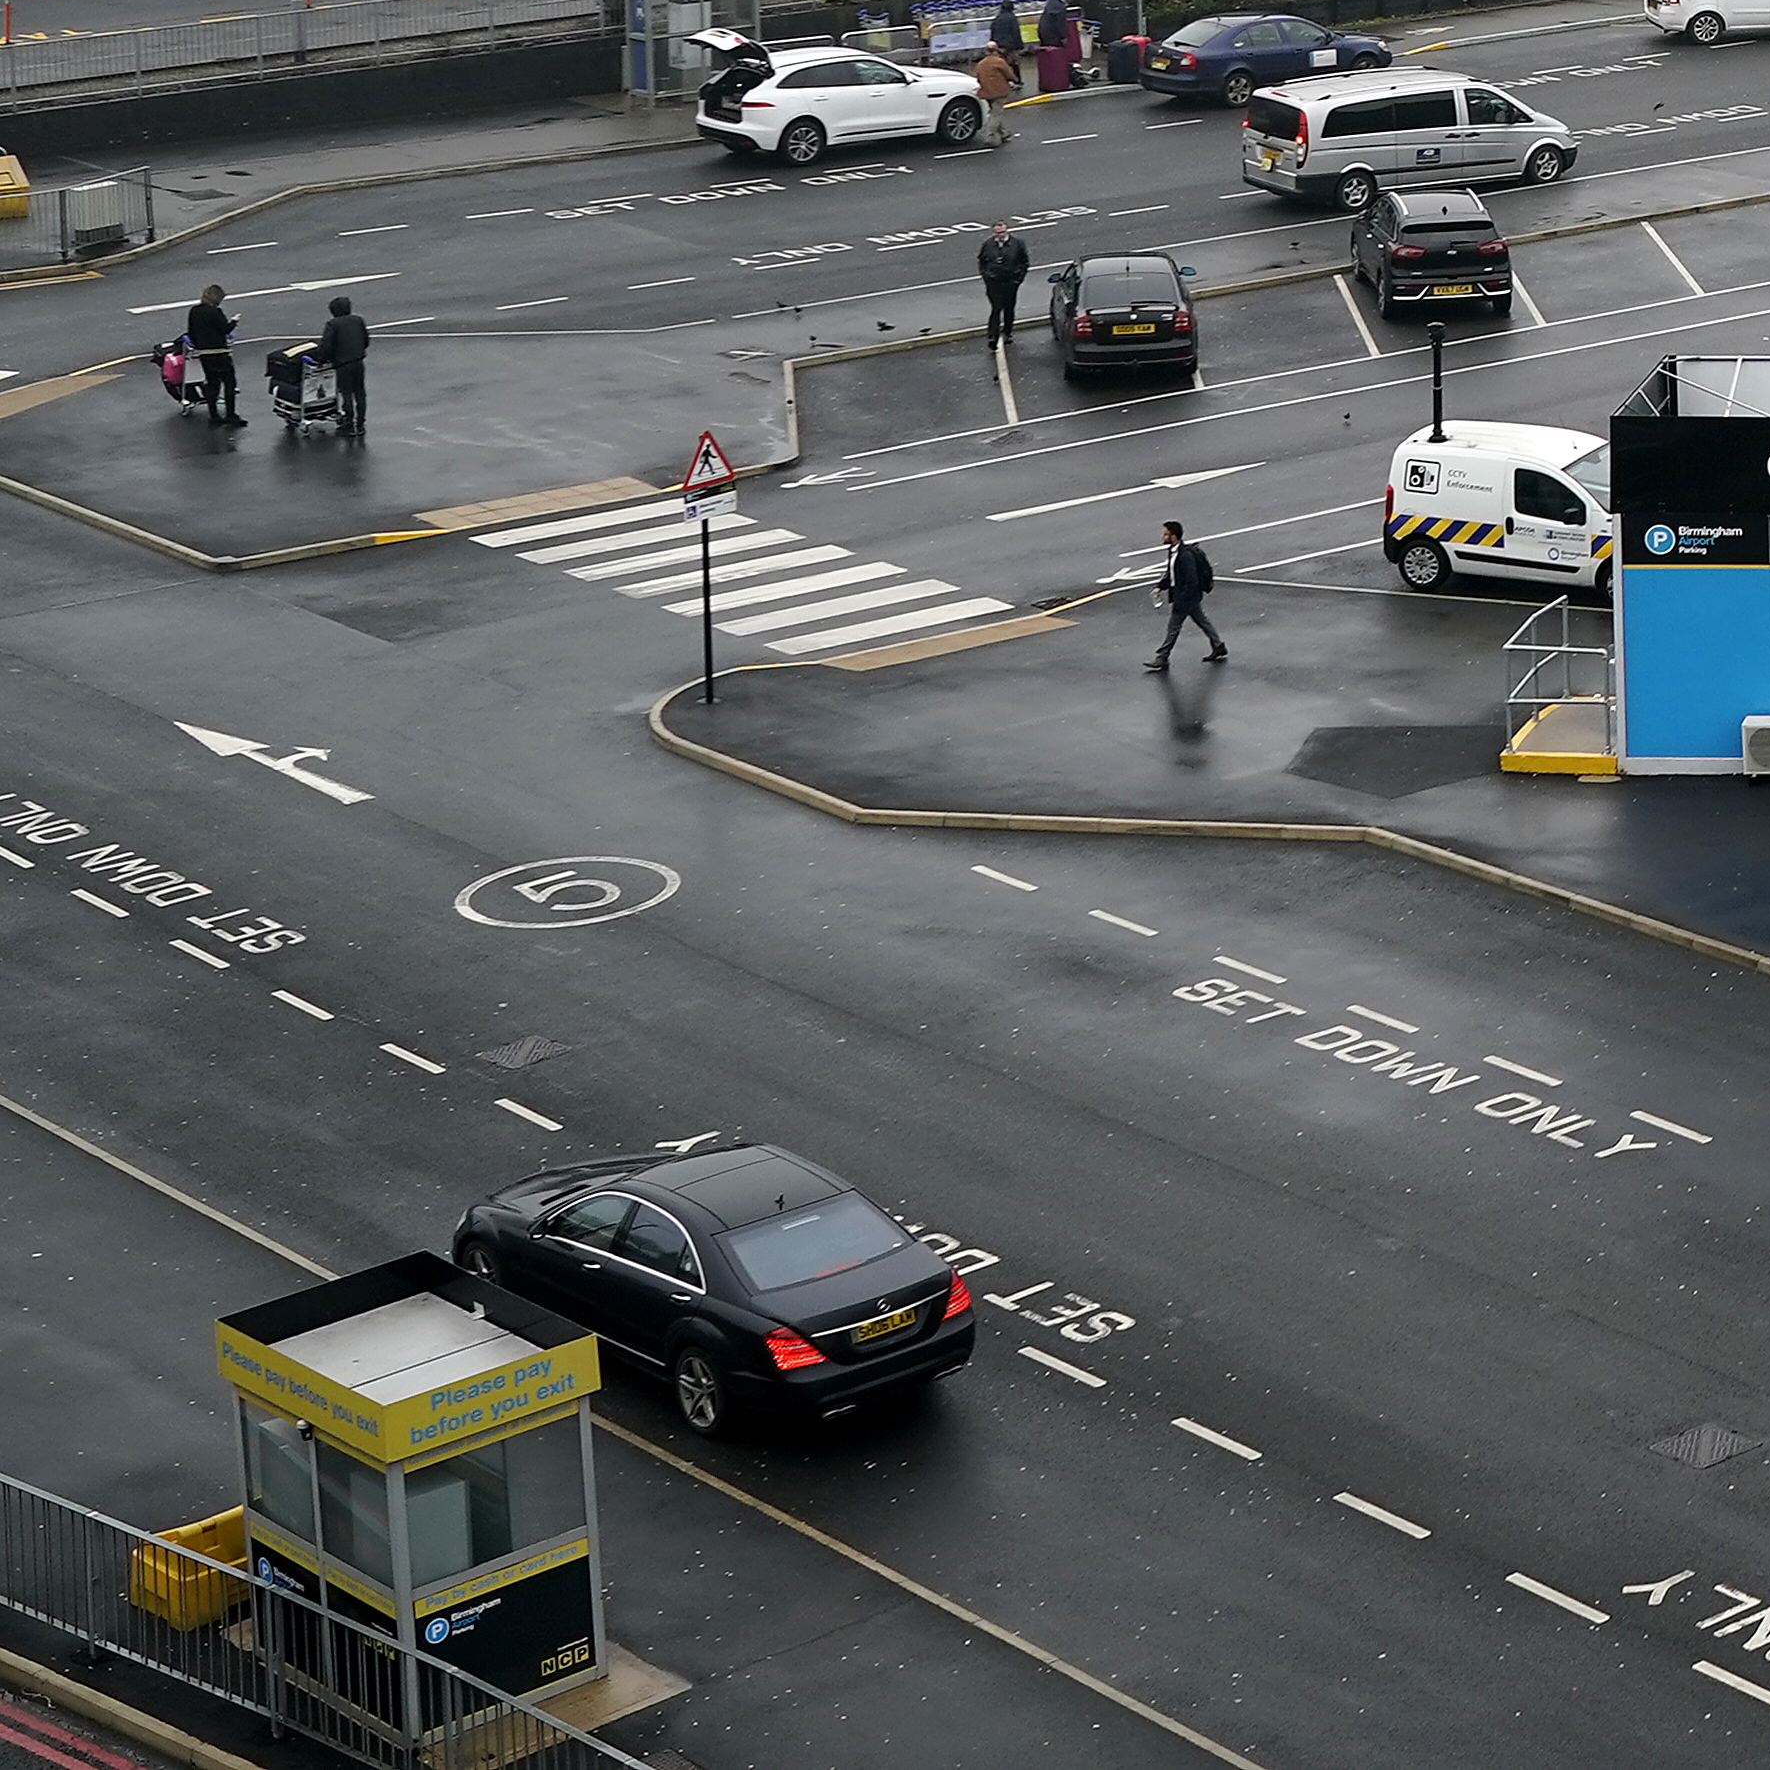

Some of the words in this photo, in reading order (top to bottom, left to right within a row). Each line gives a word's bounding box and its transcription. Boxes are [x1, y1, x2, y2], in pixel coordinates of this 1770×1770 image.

[1569, 59, 1662, 78] ONLY
[546, 201, 636, 220] SET
[658, 183, 786, 205] DOWN
[801, 165, 913, 186] ONLY
[1010, 206, 1098, 226] SET
[867, 222, 988, 246] DOWN
[731, 242, 854, 266] ONLY
[1446, 480, 1493, 494] Enforcement
[1448, 469, 1467, 479] CCTV
[1653, 532, 1668, 548] P
[1678, 526, 1743, 538] Birmingham
[1678, 537, 1715, 546] Airport
[1679, 546, 1707, 555] Parking
[0, 794, 90, 844] ONL
[68, 845, 211, 909] DOWN
[512, 870, 623, 912] 5
[187, 907, 307, 954] SET
[1172, 978, 1306, 1025] SET
[1295, 1025, 1479, 1094] DOWN
[1474, 1092, 1658, 1158] ONLY
[983, 1280, 1137, 1344] SET
[221, 1341, 262, 1377] Please
[265, 1367, 286, 1392] pay
[289, 1380, 328, 1410] before
[331, 1403, 354, 1423] you
[356, 1412, 379, 1437] exit
[430, 1374, 505, 1410] Please
[513, 1357, 553, 1389] pay
[409, 1405, 483, 1444] before
[489, 1390, 529, 1421] you
[535, 1374, 574, 1400] exit
[425, 1594, 447, 1608] Pay
[452, 1586, 465, 1600] by
[470, 1576, 499, 1592] cash
[503, 1569, 515, 1581] or
[519, 1556, 547, 1573] card
[550, 1546, 577, 1561] here
[451, 1598, 501, 1621] Birmingham
[541, 1644, 589, 1676] NCP
